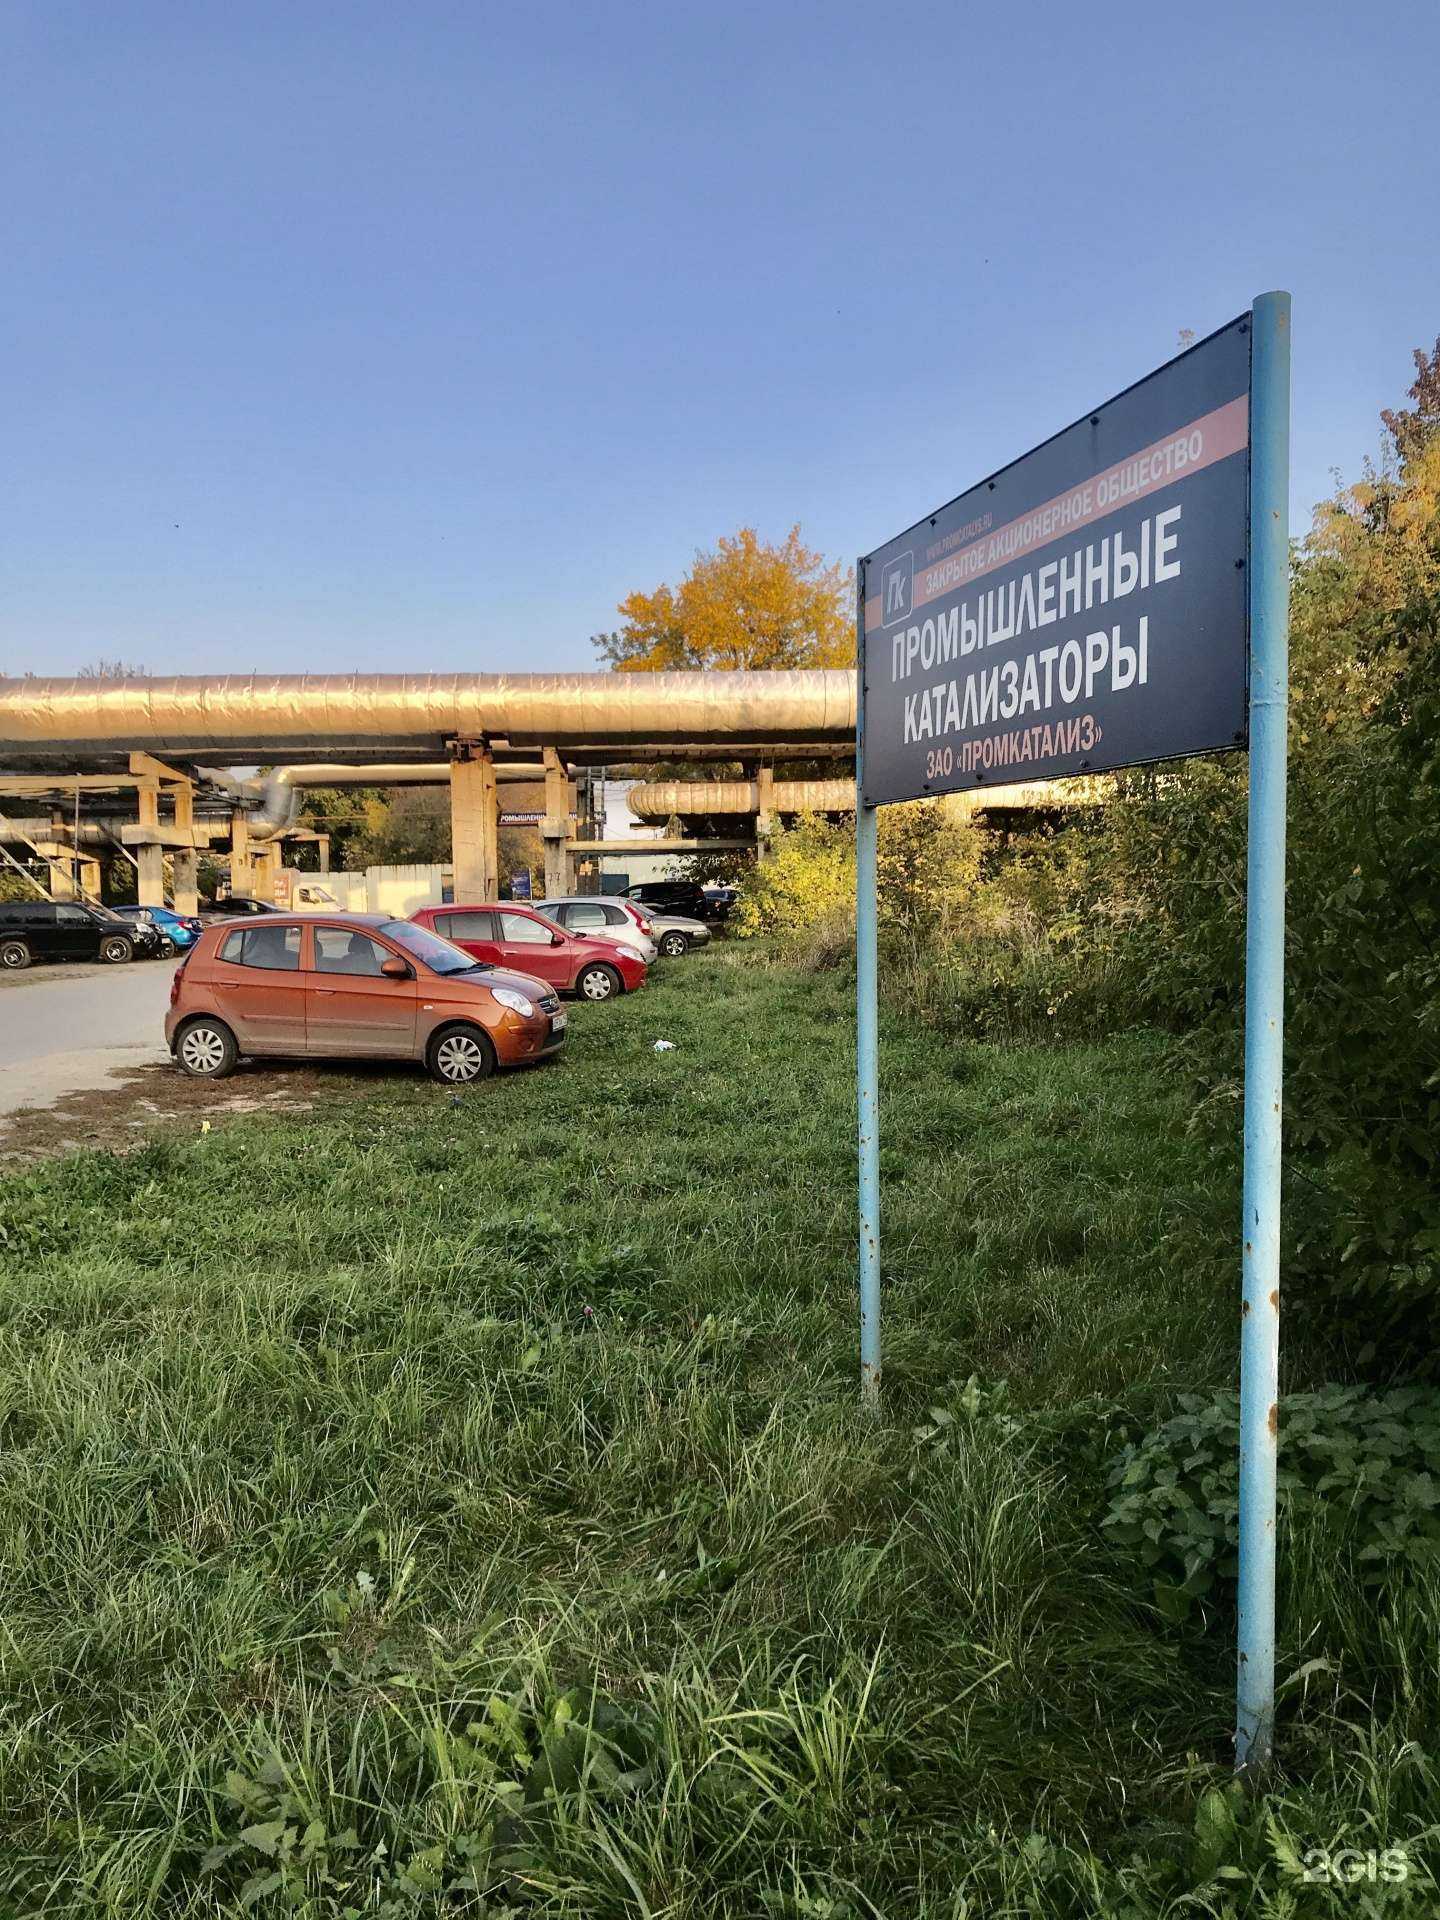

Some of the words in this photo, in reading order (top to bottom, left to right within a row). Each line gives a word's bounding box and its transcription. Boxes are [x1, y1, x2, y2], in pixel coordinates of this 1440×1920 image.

[926, 549, 985, 595] ЗАКРЫТОЕ
[987, 487, 1093, 566] АКЦИОНЕРНОЕ
[1096, 429, 1203, 509] ОБЩЕСТВО
[892, 504, 1182, 682] ПРОМЫШЛЕННЫЕ
[904, 615, 1149, 744] КАТАЛИЗАТОРЫ
[926, 746, 953, 780] ЗАО
[956, 714, 1103, 773] «ПРОМКАТАЛИЗ»
